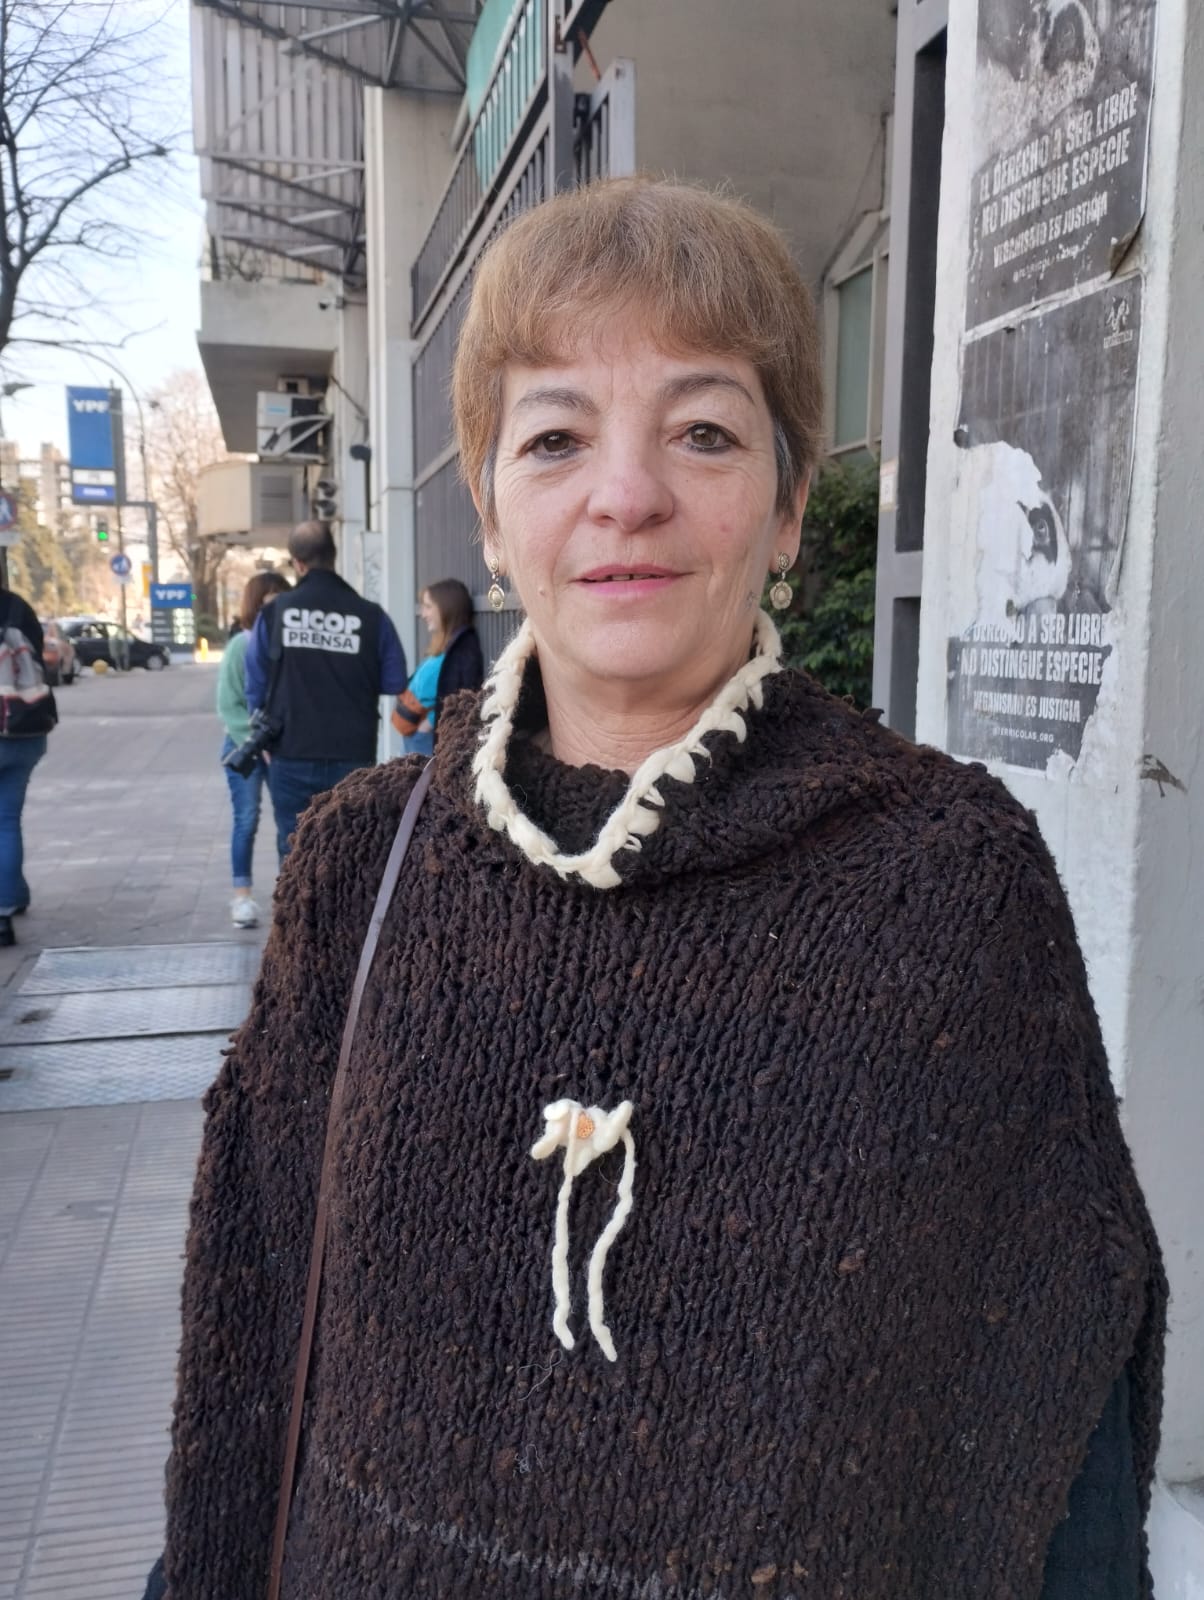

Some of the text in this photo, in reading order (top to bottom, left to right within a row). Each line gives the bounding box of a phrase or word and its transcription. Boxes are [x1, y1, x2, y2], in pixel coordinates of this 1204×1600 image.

[980, 81, 1138, 203] EL DERECHO A SER LIBRE
[981, 128, 1131, 238] NO DISTINGUE ESPECIE
[1048, 214, 1063, 241] ES
[73, 400, 109, 413] YPF
[155, 589, 186, 601] YPF
[283, 608, 362, 636] CICOP
[1028, 613, 1037, 644] A
[1040, 613, 1067, 645] SER
[289, 631, 353, 650] PRENSA
[960, 648, 1102, 685] NO DISTINGUE ESPECIE
[973, 690, 1080, 723] VEGANISMO ES JUSTICIA
